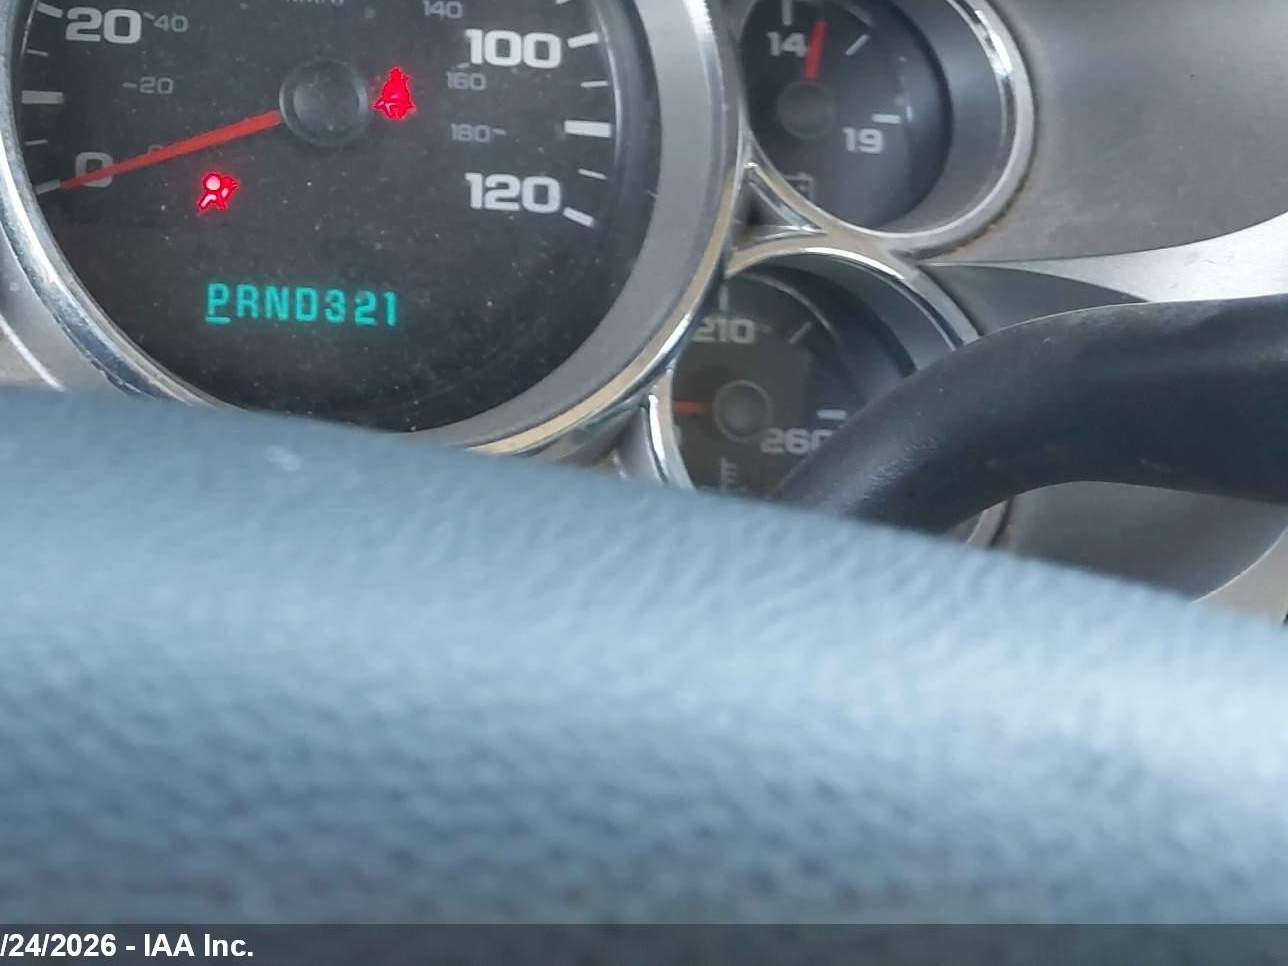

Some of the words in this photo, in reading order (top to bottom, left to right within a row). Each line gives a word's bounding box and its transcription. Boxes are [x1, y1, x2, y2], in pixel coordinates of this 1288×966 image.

[65, 8, 142, 45] 20
[153, 13, 189, 34] 40
[465, 28, 563, 70] 100
[765, 31, 811, 58] 14
[138, 75, 174, 95] 20
[445, 70, 487, 92] 160
[450, 122, 492, 144] 180
[841, 126, 885, 154] 19
[465, 171, 562, 214] 120
